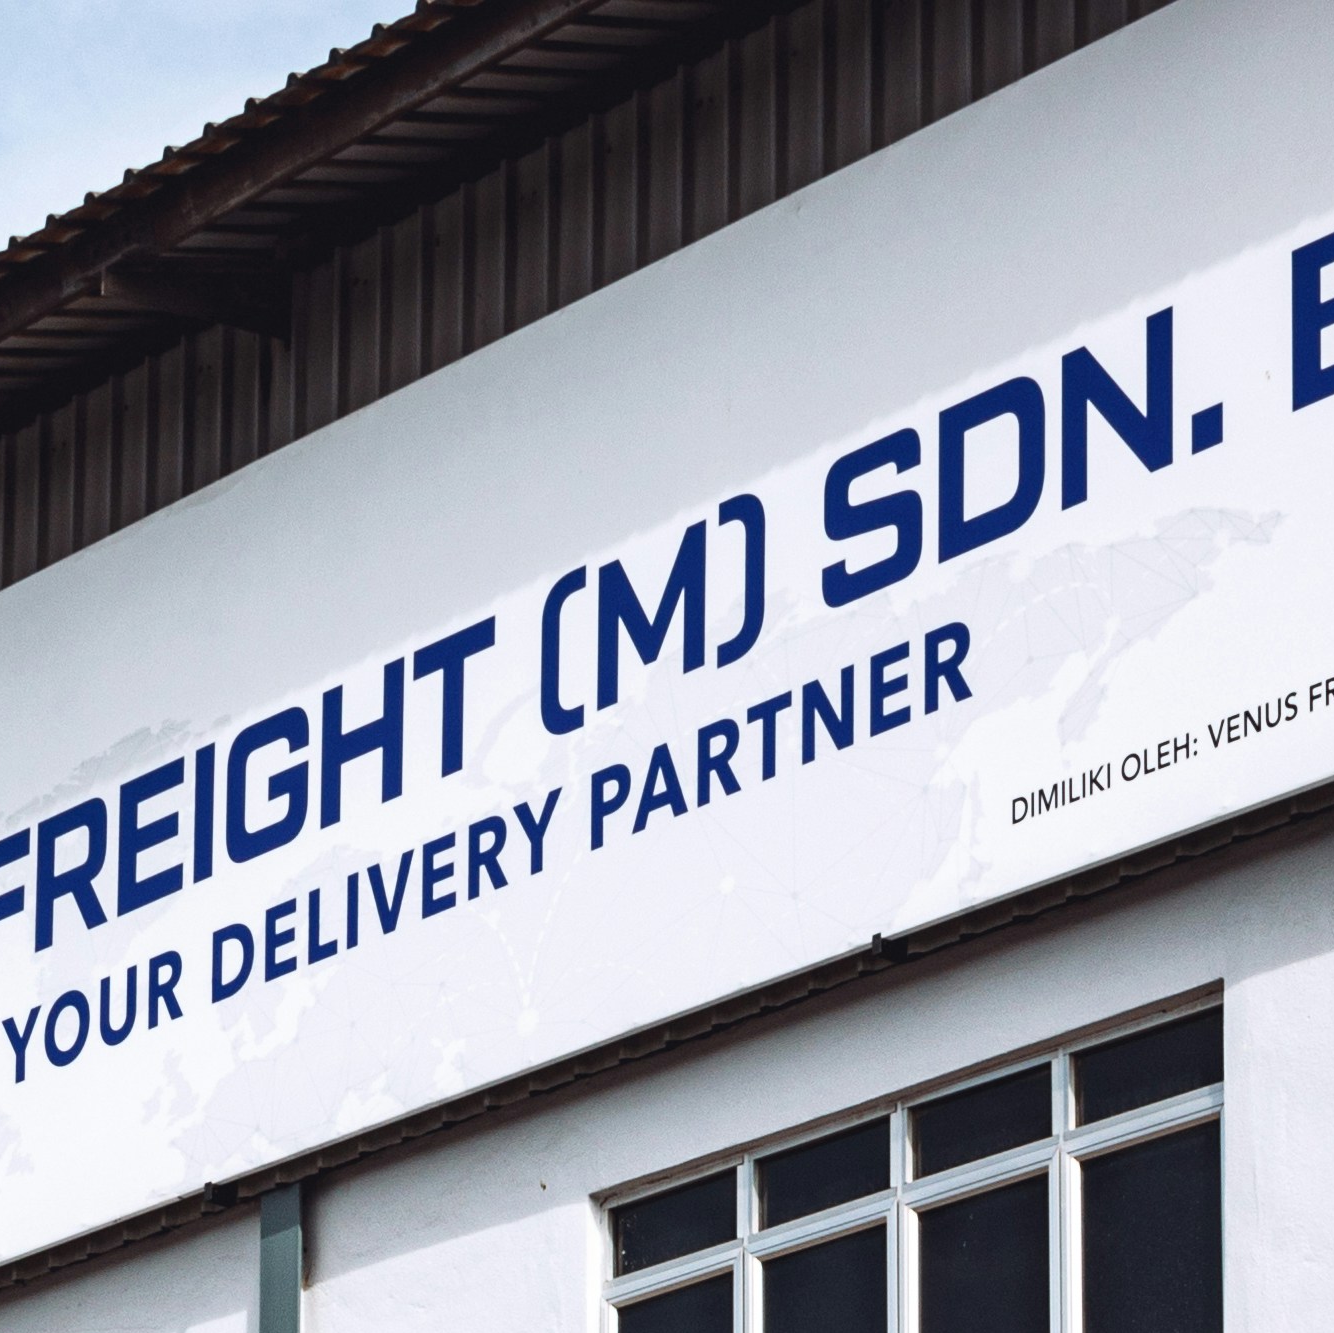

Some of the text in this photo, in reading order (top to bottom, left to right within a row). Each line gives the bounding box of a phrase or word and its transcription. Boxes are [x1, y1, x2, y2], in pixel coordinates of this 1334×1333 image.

[540, 493, 766, 736] (M)
[821, 305, 1224, 609] SDN.
[1, 621, 973, 1084] YOUR DELIVERY PARTNER
[1010, 762, 1112, 825] DIMILIKI
[1120, 732, 1199, 782] OLEH:
[1207, 691, 1299, 749] VENUS
